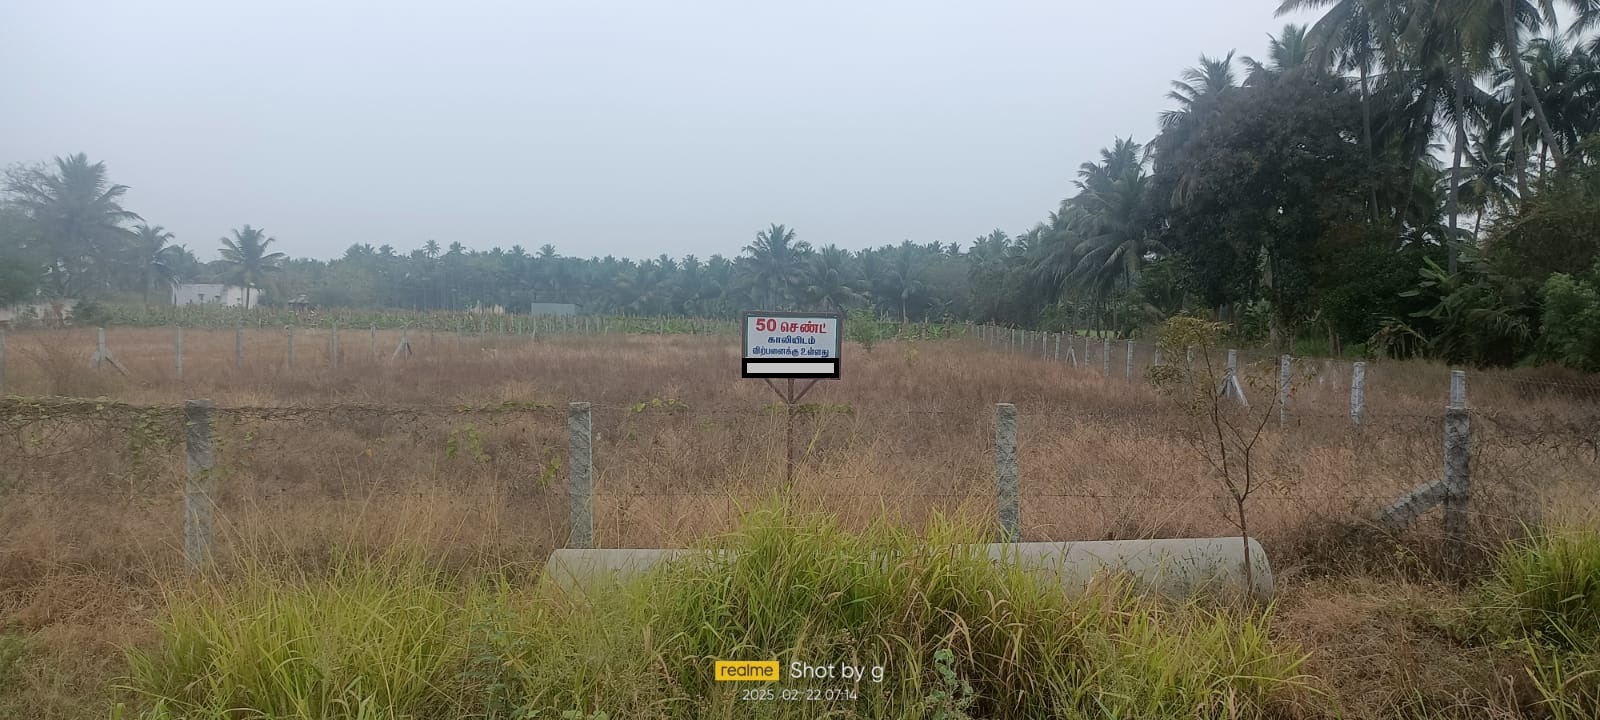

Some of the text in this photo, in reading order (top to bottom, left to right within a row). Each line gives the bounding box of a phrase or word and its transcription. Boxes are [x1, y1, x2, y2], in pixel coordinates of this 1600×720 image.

[756, 318, 827, 334] 50 செண்ட்
[767, 335, 816, 345] காலியிடம்
[752, 346, 829, 357] விற்பனைக்கு உள்ளது
